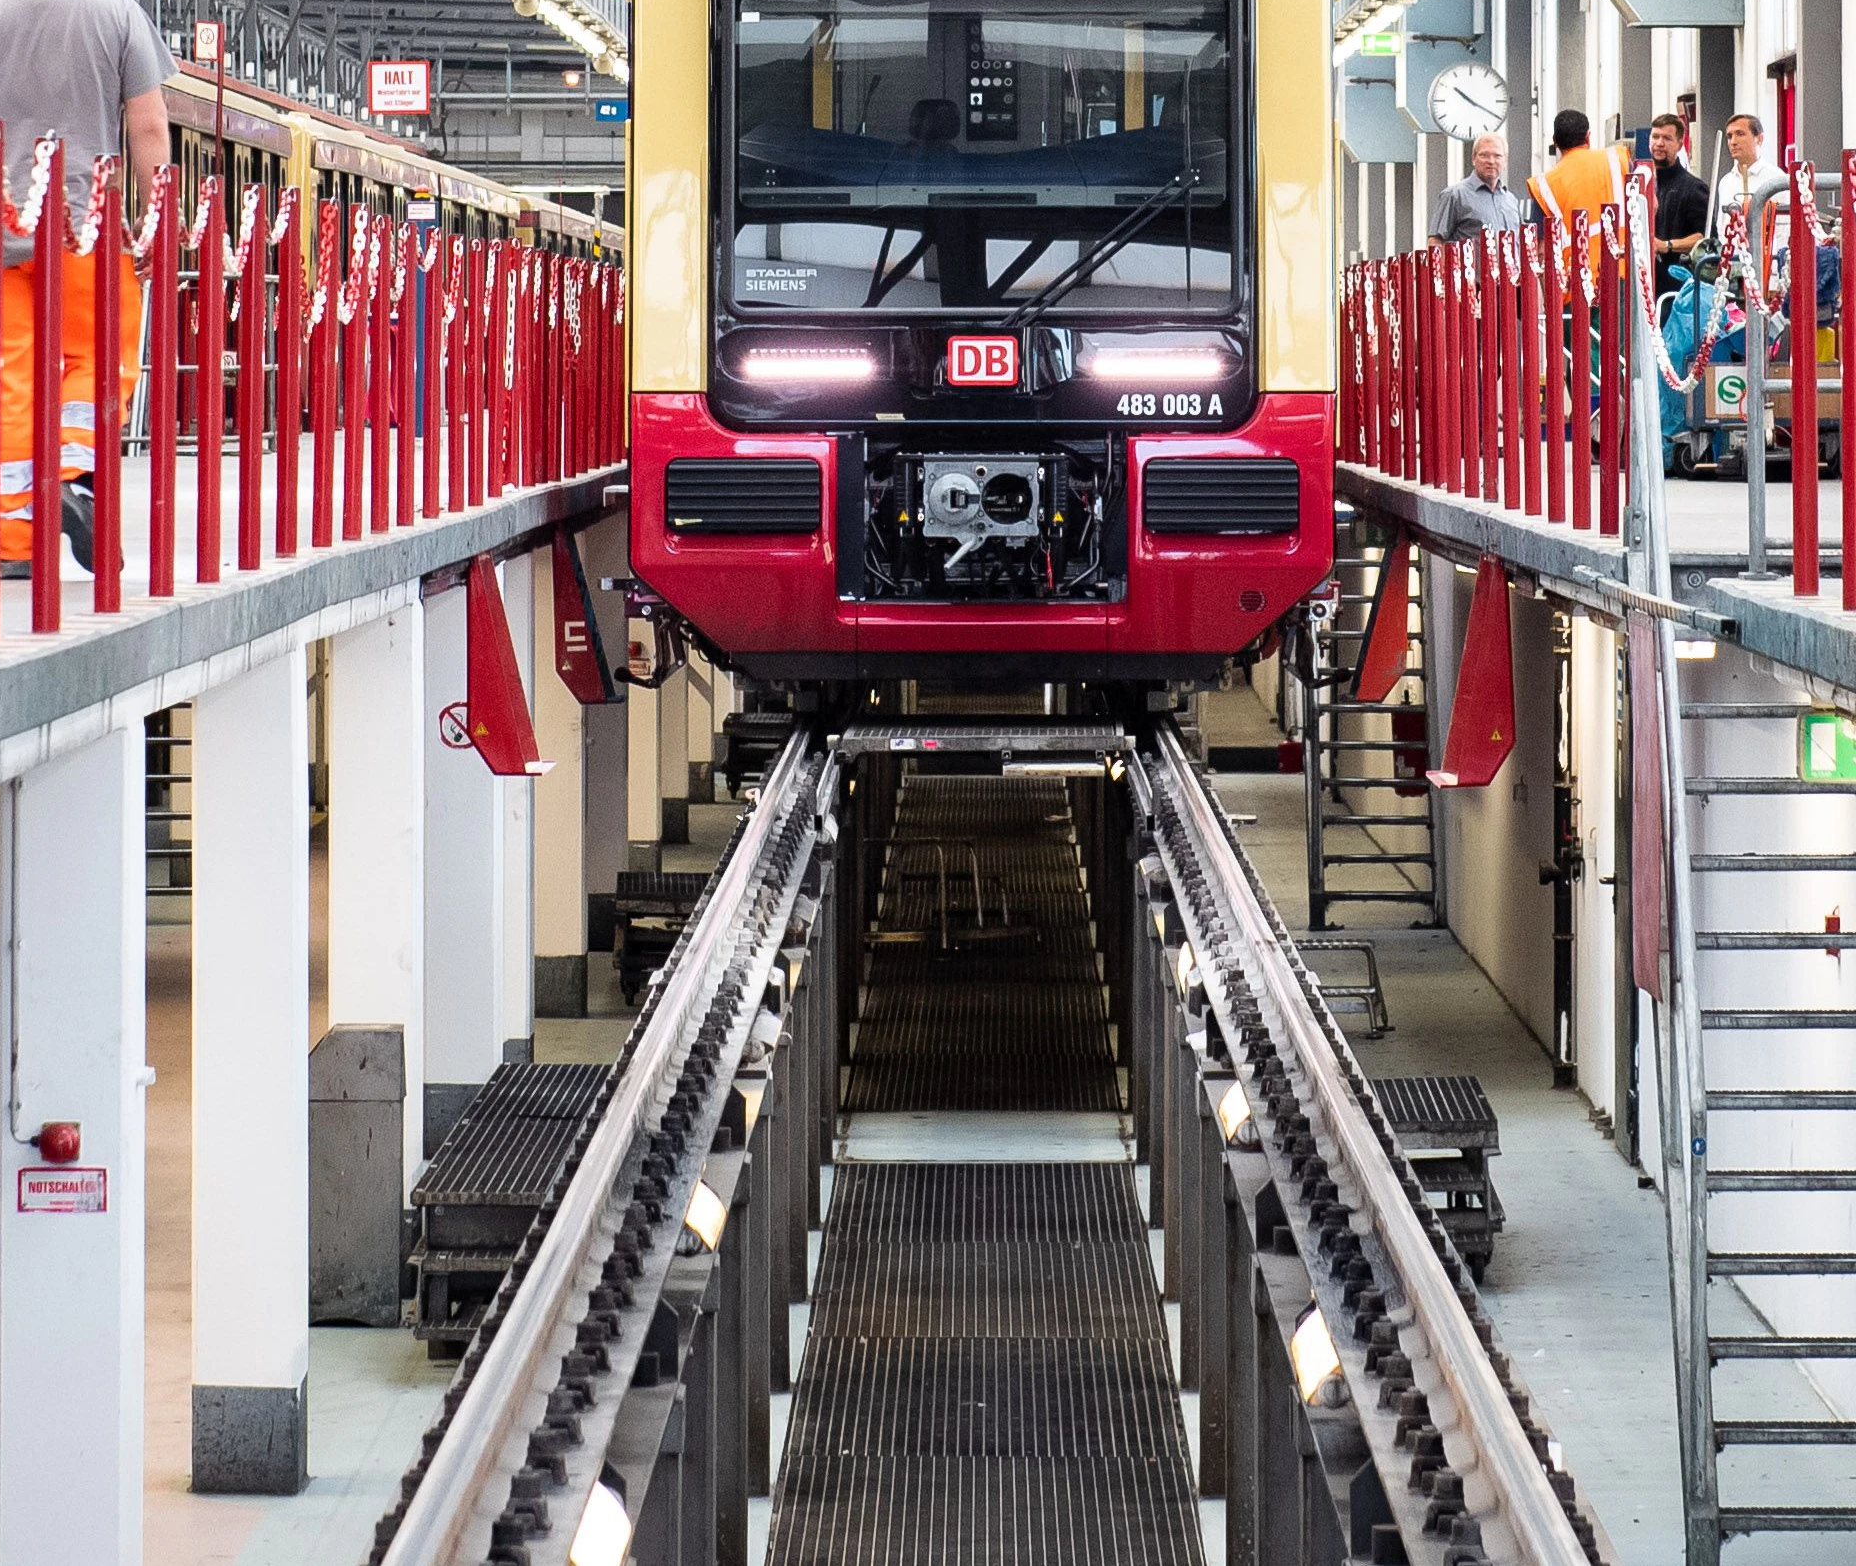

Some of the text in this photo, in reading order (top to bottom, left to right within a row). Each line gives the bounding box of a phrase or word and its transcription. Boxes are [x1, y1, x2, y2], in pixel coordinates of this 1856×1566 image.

[384, 71, 413, 85] HALT
[745, 268, 818, 278] STADLER
[745, 279, 807, 291] SIEMENS
[957, 345, 1009, 377] DB
[1721, 377, 1745, 403] S
[1117, 394, 1223, 416] 483 003 A
